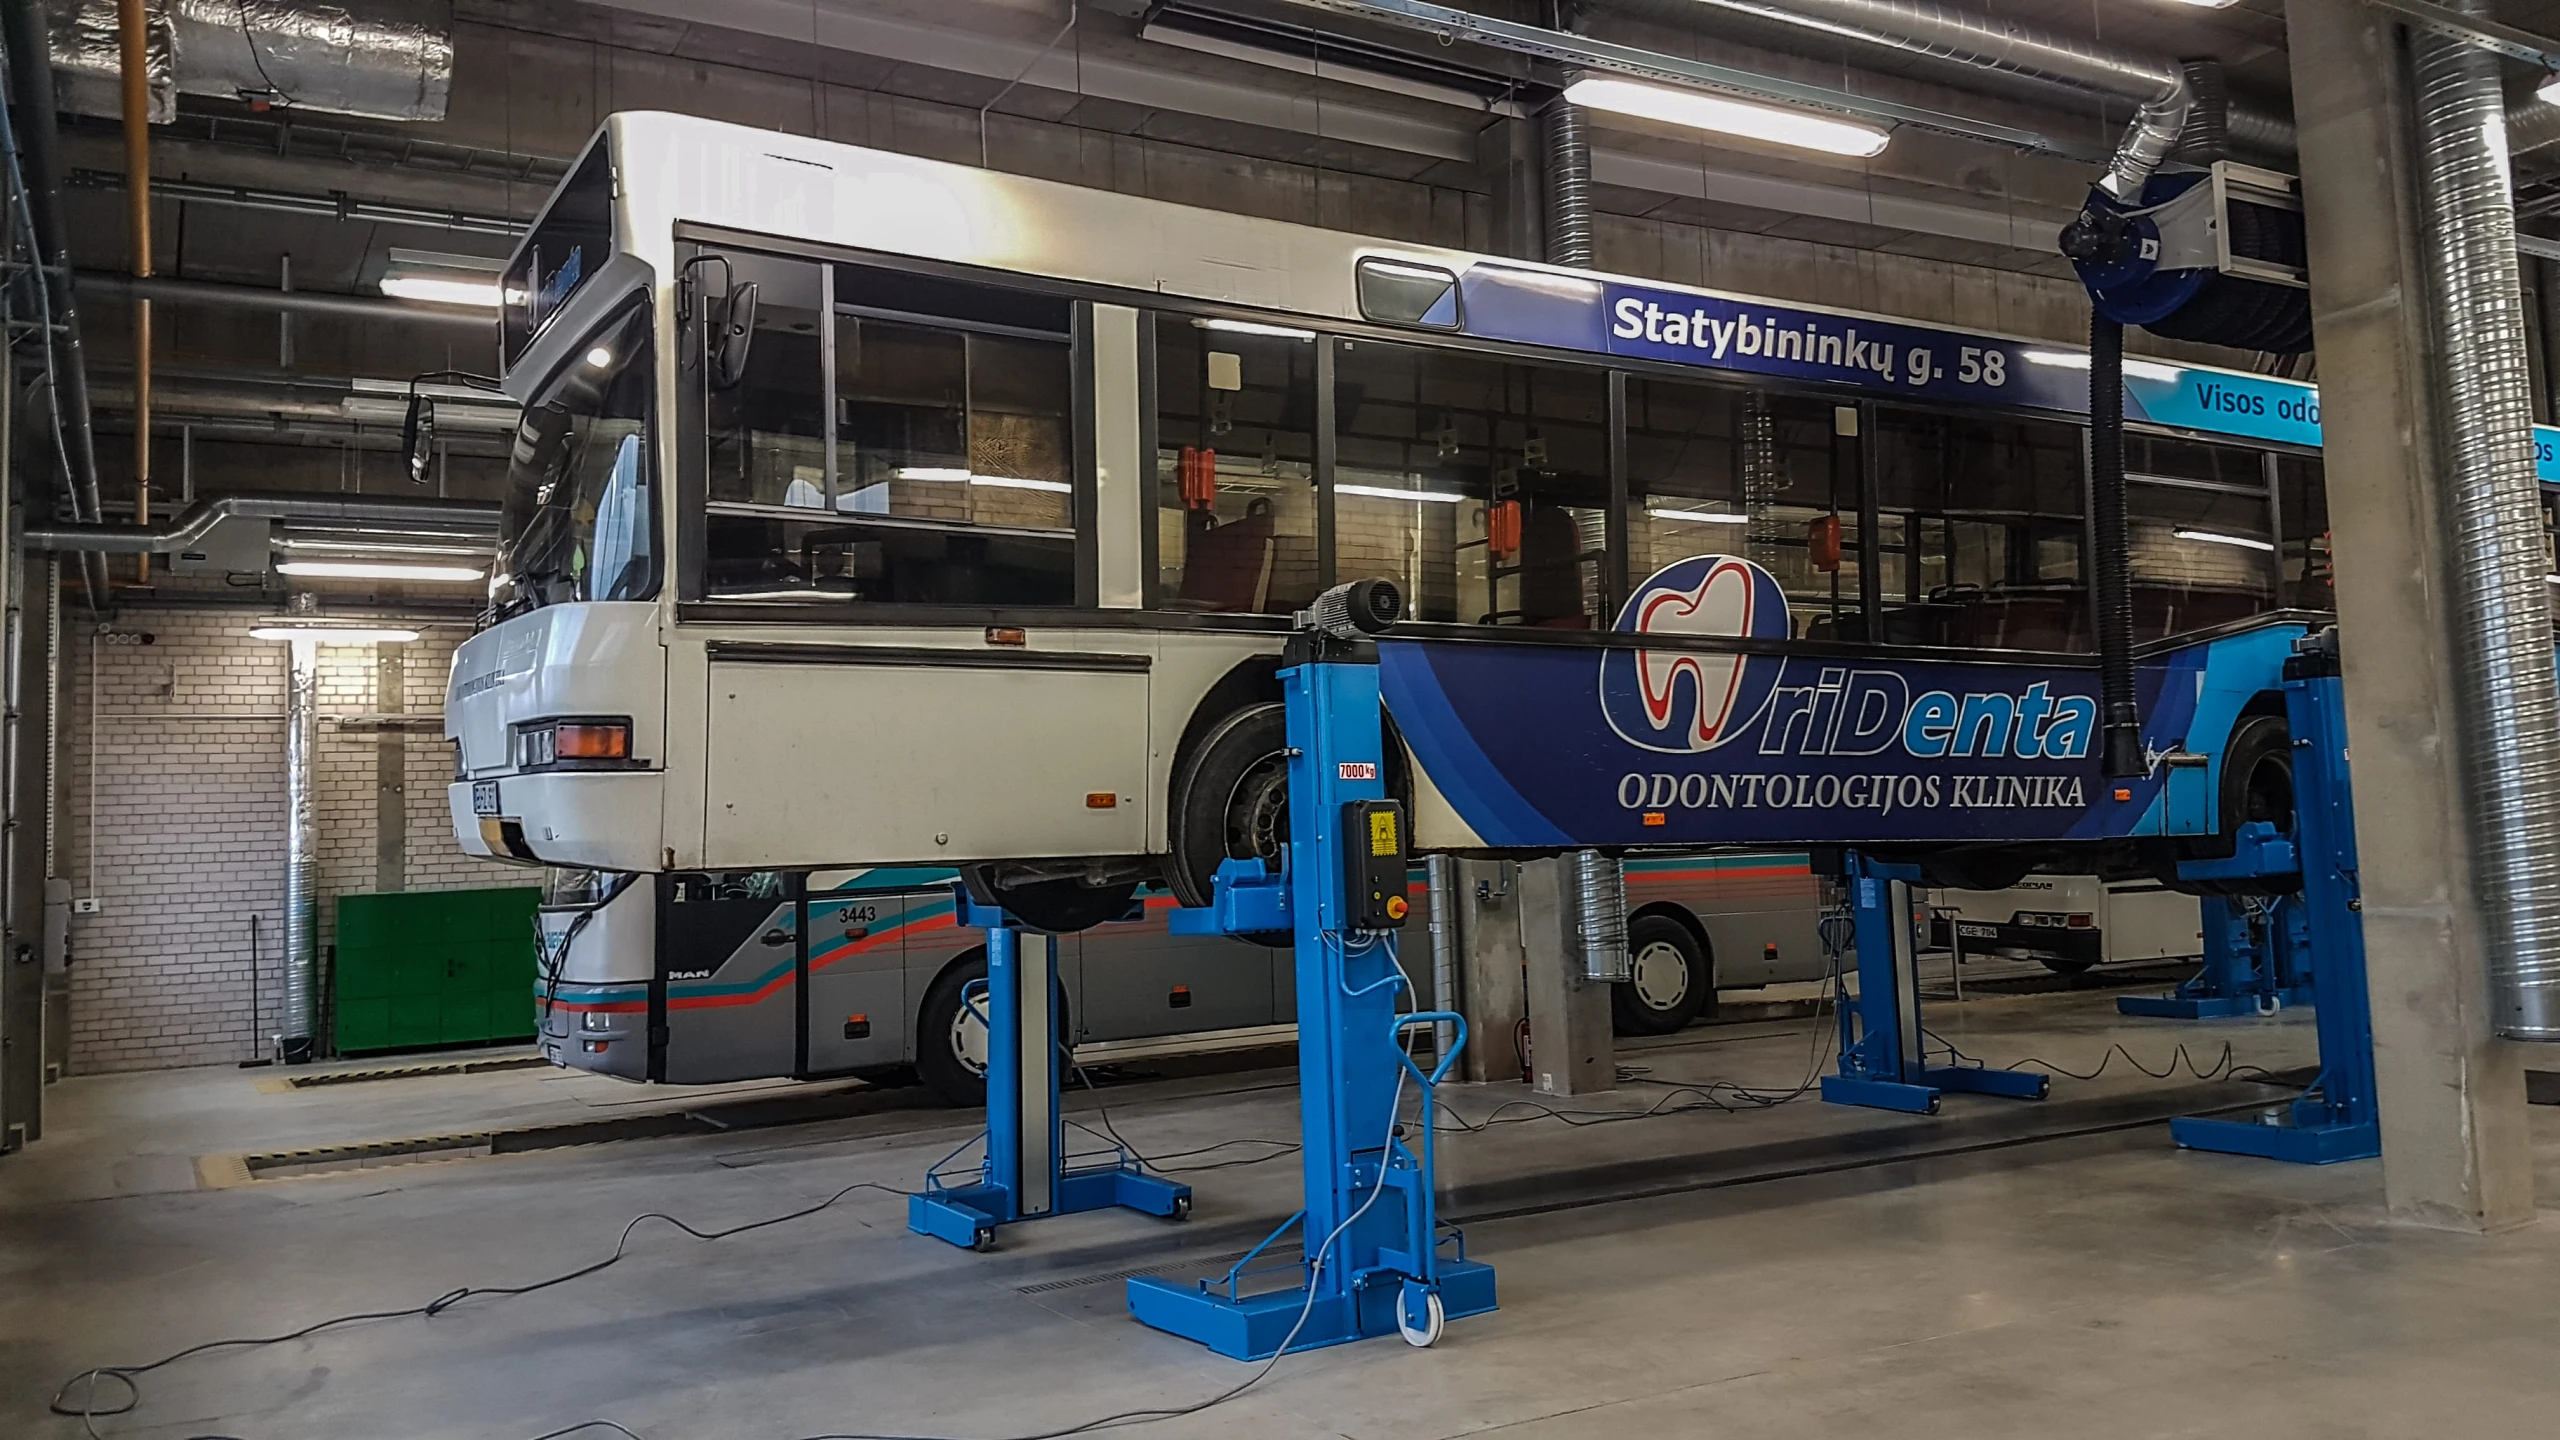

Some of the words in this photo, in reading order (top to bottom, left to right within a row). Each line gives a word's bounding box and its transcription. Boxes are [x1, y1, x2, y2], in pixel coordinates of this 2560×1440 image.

[1613, 297, 1894, 382] Statybininkų
[1908, 346, 1943, 386] g.
[1958, 347, 2006, 387] 58
[2196, 382, 2265, 416] Visos
[2277, 396, 2321, 425] odo
[1340, 764, 1364, 778] 7000
[1365, 764, 1375, 778] kg
[1617, 772, 1941, 817] ODONTOLOGIJOS
[1949, 774, 2087, 808] KLINIKA
[839, 906, 876, 924] 3443
[668, 968, 710, 980] MAN
